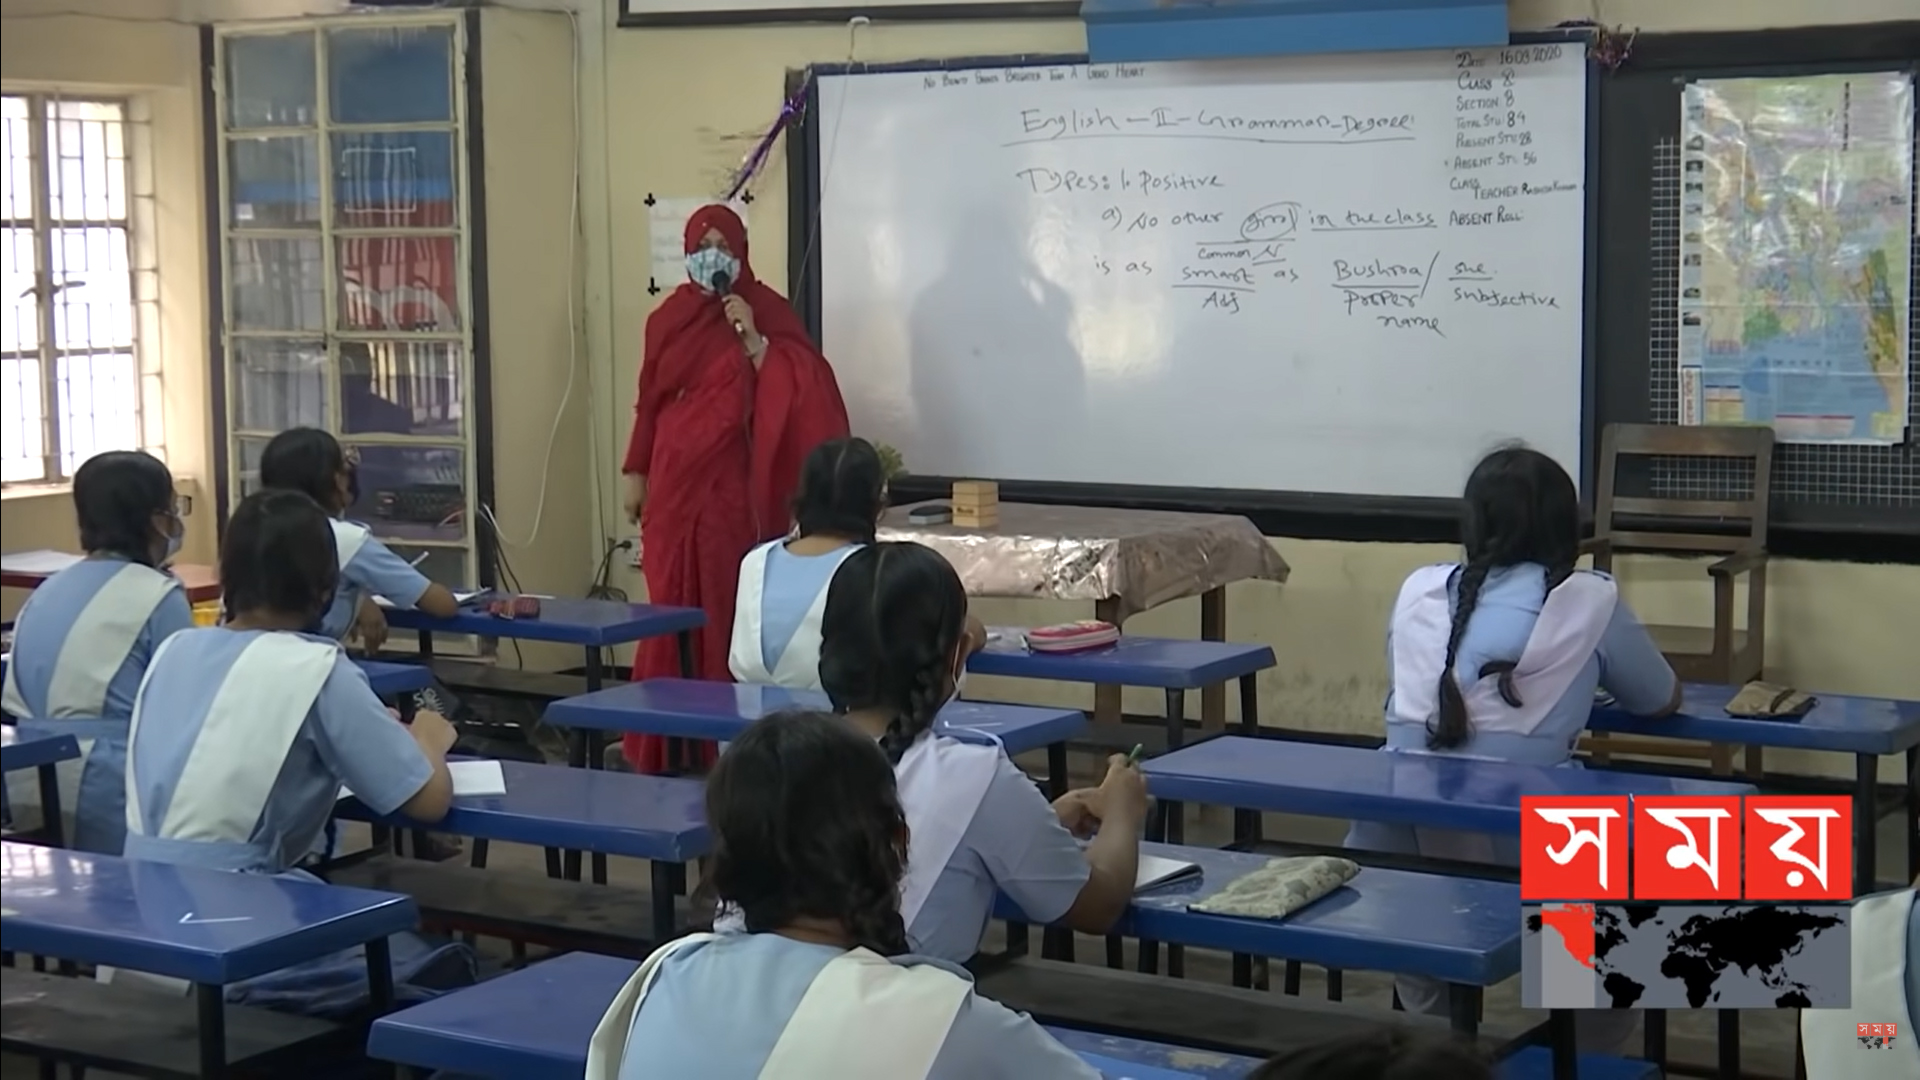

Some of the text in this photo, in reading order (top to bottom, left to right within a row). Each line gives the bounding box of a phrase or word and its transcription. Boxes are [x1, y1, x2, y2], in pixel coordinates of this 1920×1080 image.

[1020, 108, 1120, 139] English
[1093, 256, 1110, 275] is
[1126, 261, 1152, 275] as
[1274, 268, 1299, 282] as
